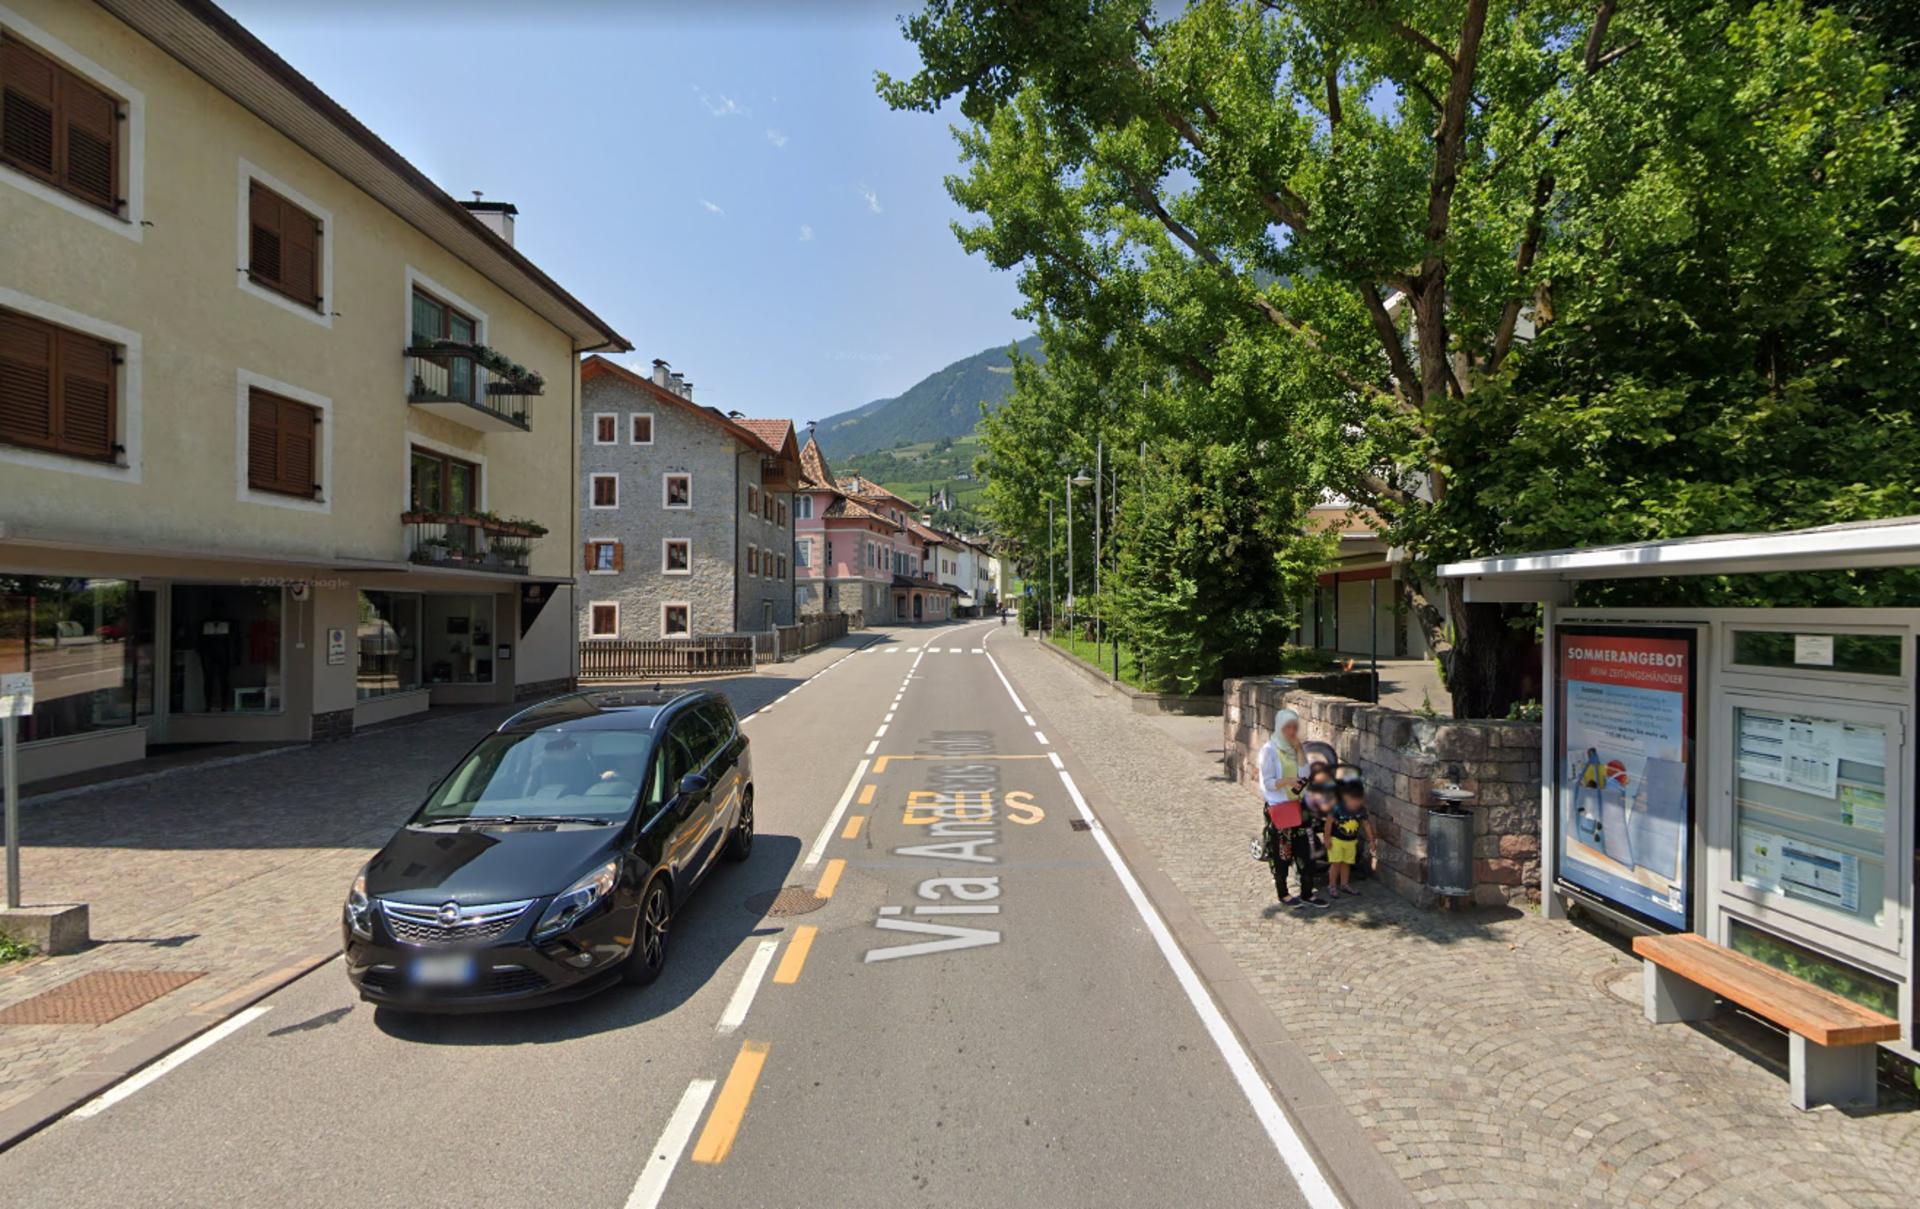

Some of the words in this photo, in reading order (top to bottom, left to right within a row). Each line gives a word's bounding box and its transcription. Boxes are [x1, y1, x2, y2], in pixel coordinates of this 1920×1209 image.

[1568, 648, 1684, 667] SOMMERANGEBOT
[1609, 669, 1683, 683] ZEITUNGSHÄNDLER
[902, 790, 1046, 826] BUS
